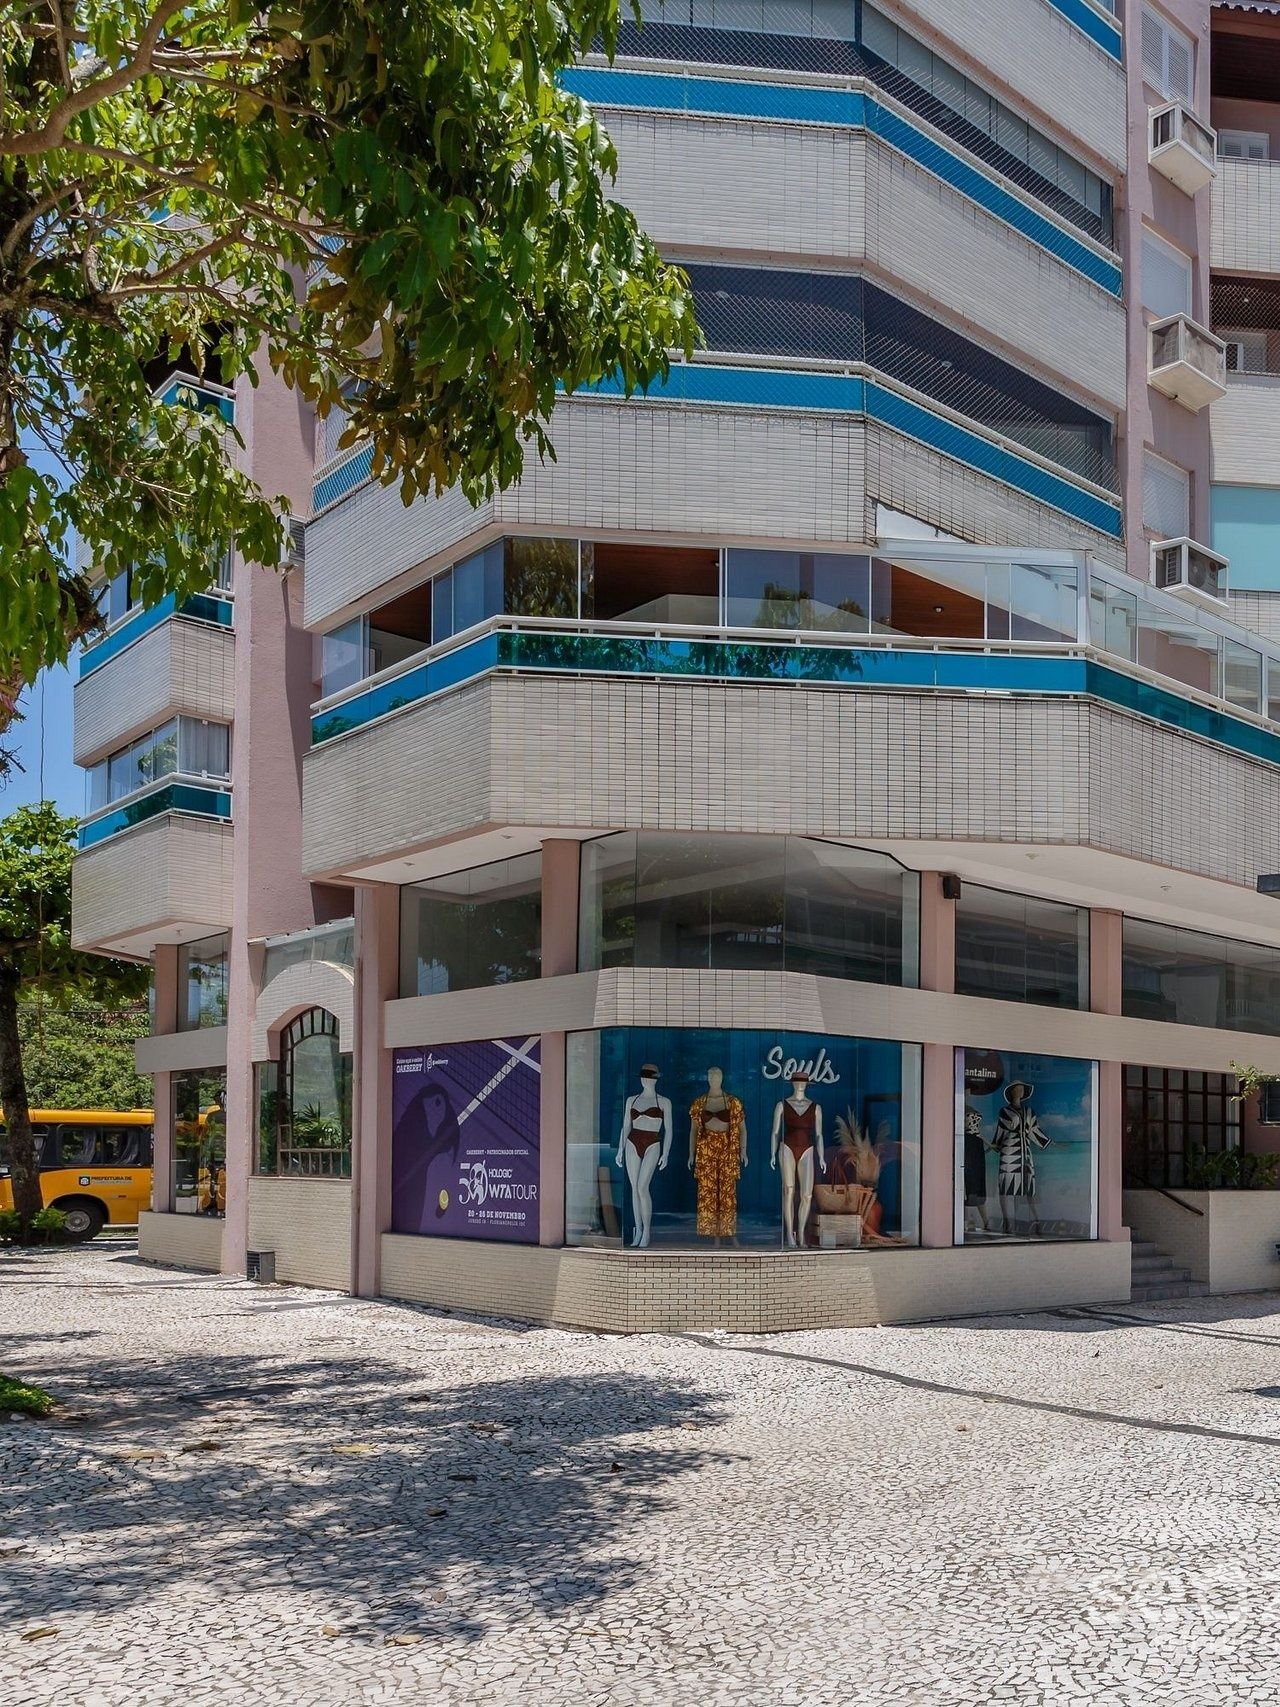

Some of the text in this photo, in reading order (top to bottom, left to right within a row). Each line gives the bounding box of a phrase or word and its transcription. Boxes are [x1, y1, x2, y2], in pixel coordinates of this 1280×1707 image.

[762, 1046, 840, 1083] Souls
[488, 1168, 513, 1178] HOLOGIC
[495, 1211, 526, 1220] NOVEMBRO
